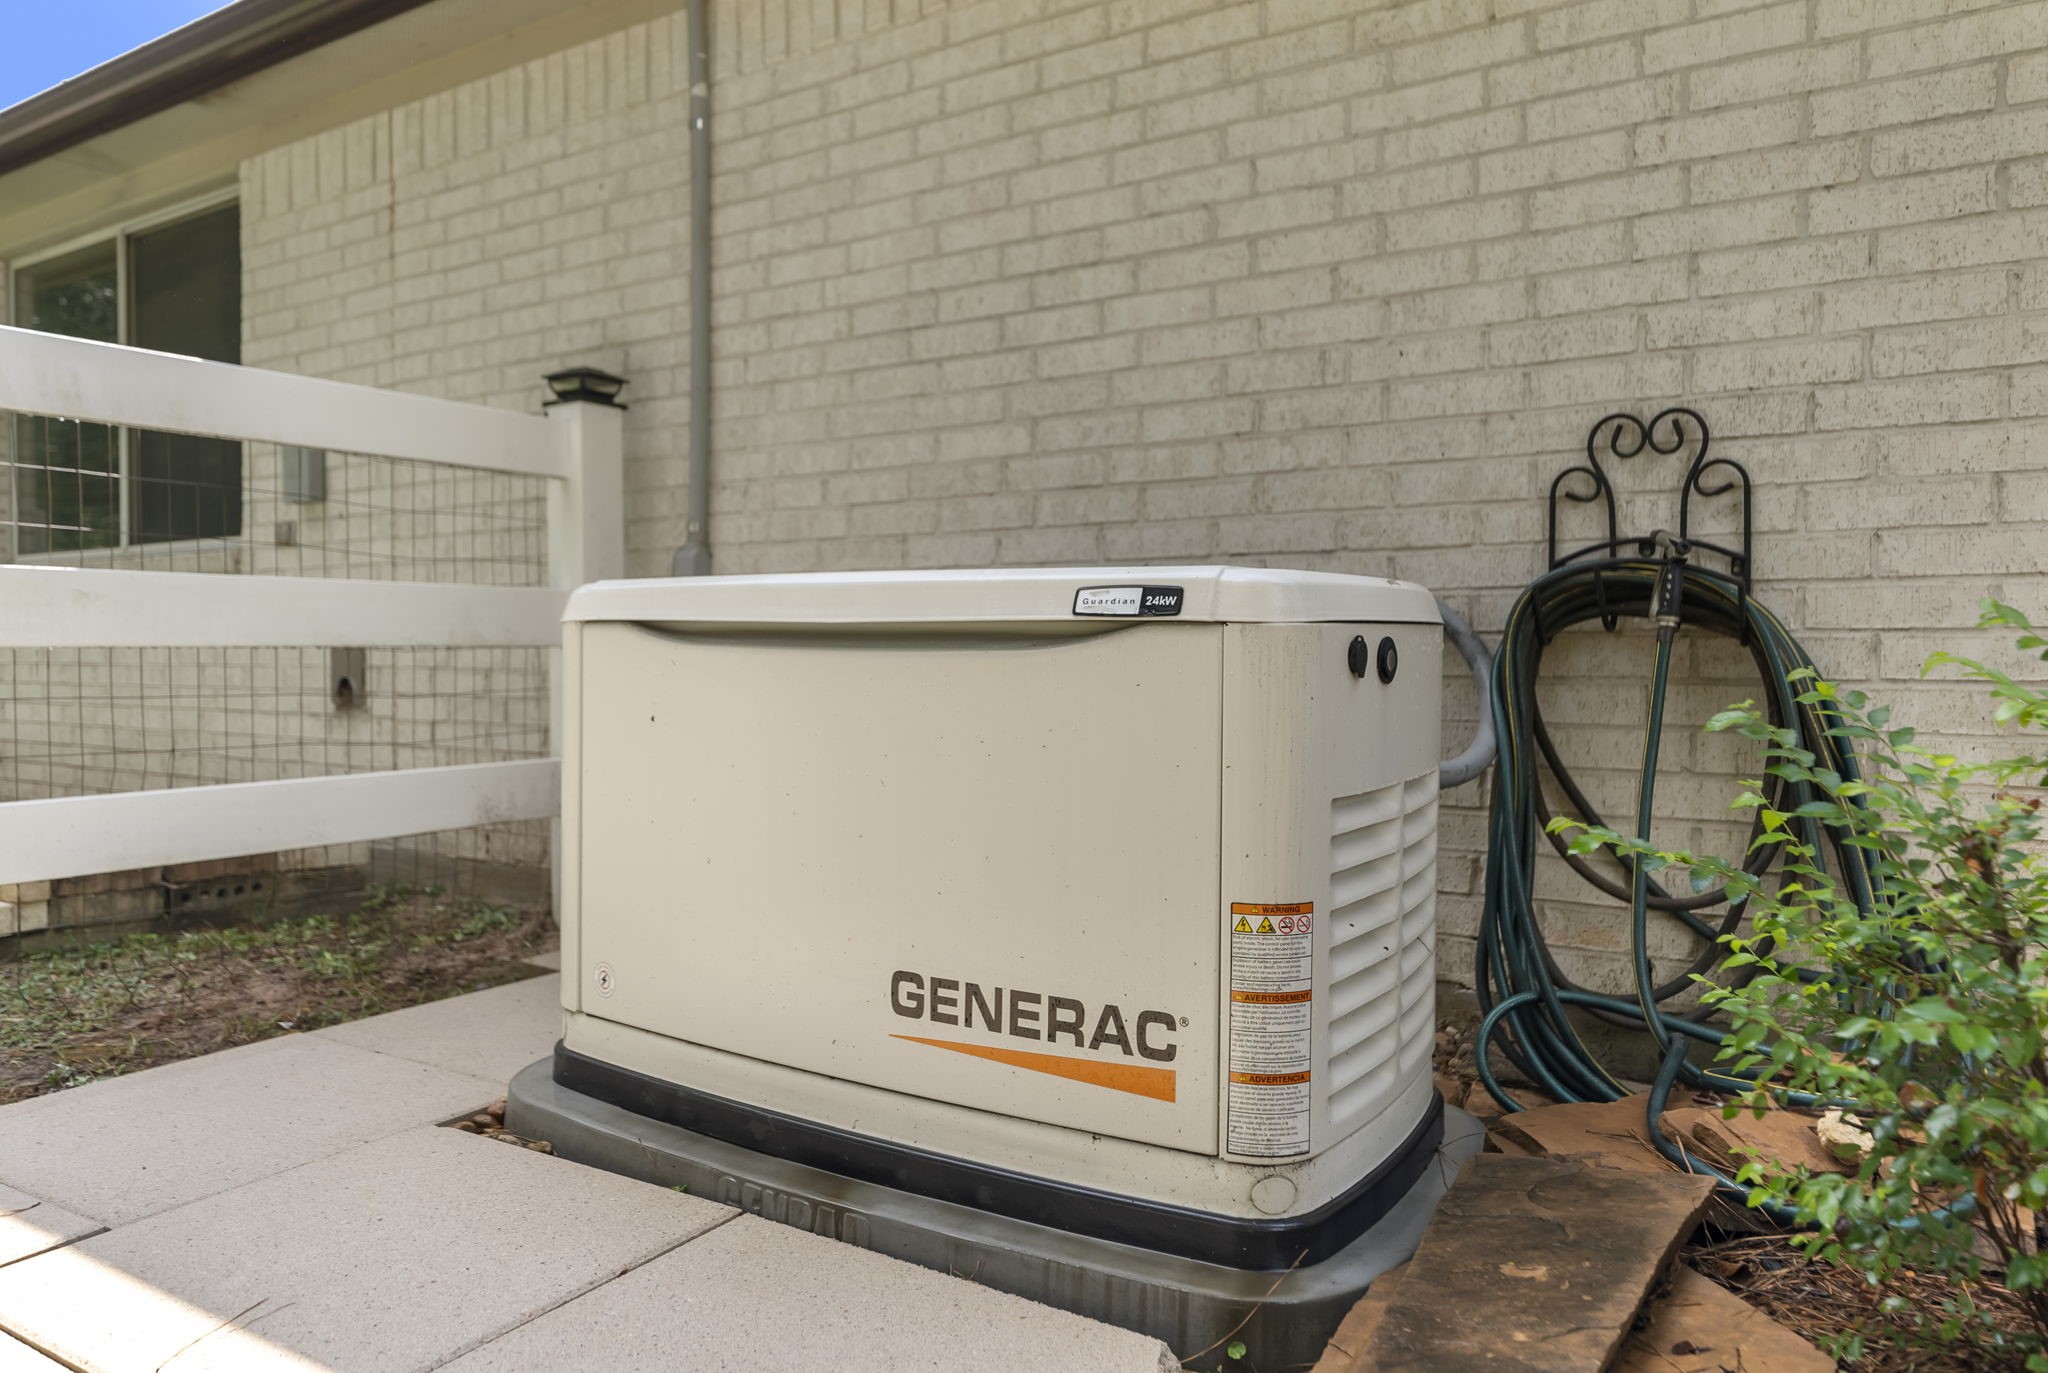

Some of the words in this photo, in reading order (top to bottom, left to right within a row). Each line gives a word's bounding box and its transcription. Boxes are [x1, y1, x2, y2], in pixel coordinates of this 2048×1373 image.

[1082, 597, 1136, 605] Guardian
[1145, 596, 1177, 606] 24kW
[1262, 906, 1300, 914] WARNING
[1244, 992, 1309, 1002] AVERTISSEMENT
[891, 970, 1177, 1062] GENERAC
[1249, 1074, 1305, 1084] ADVERTENCIA
